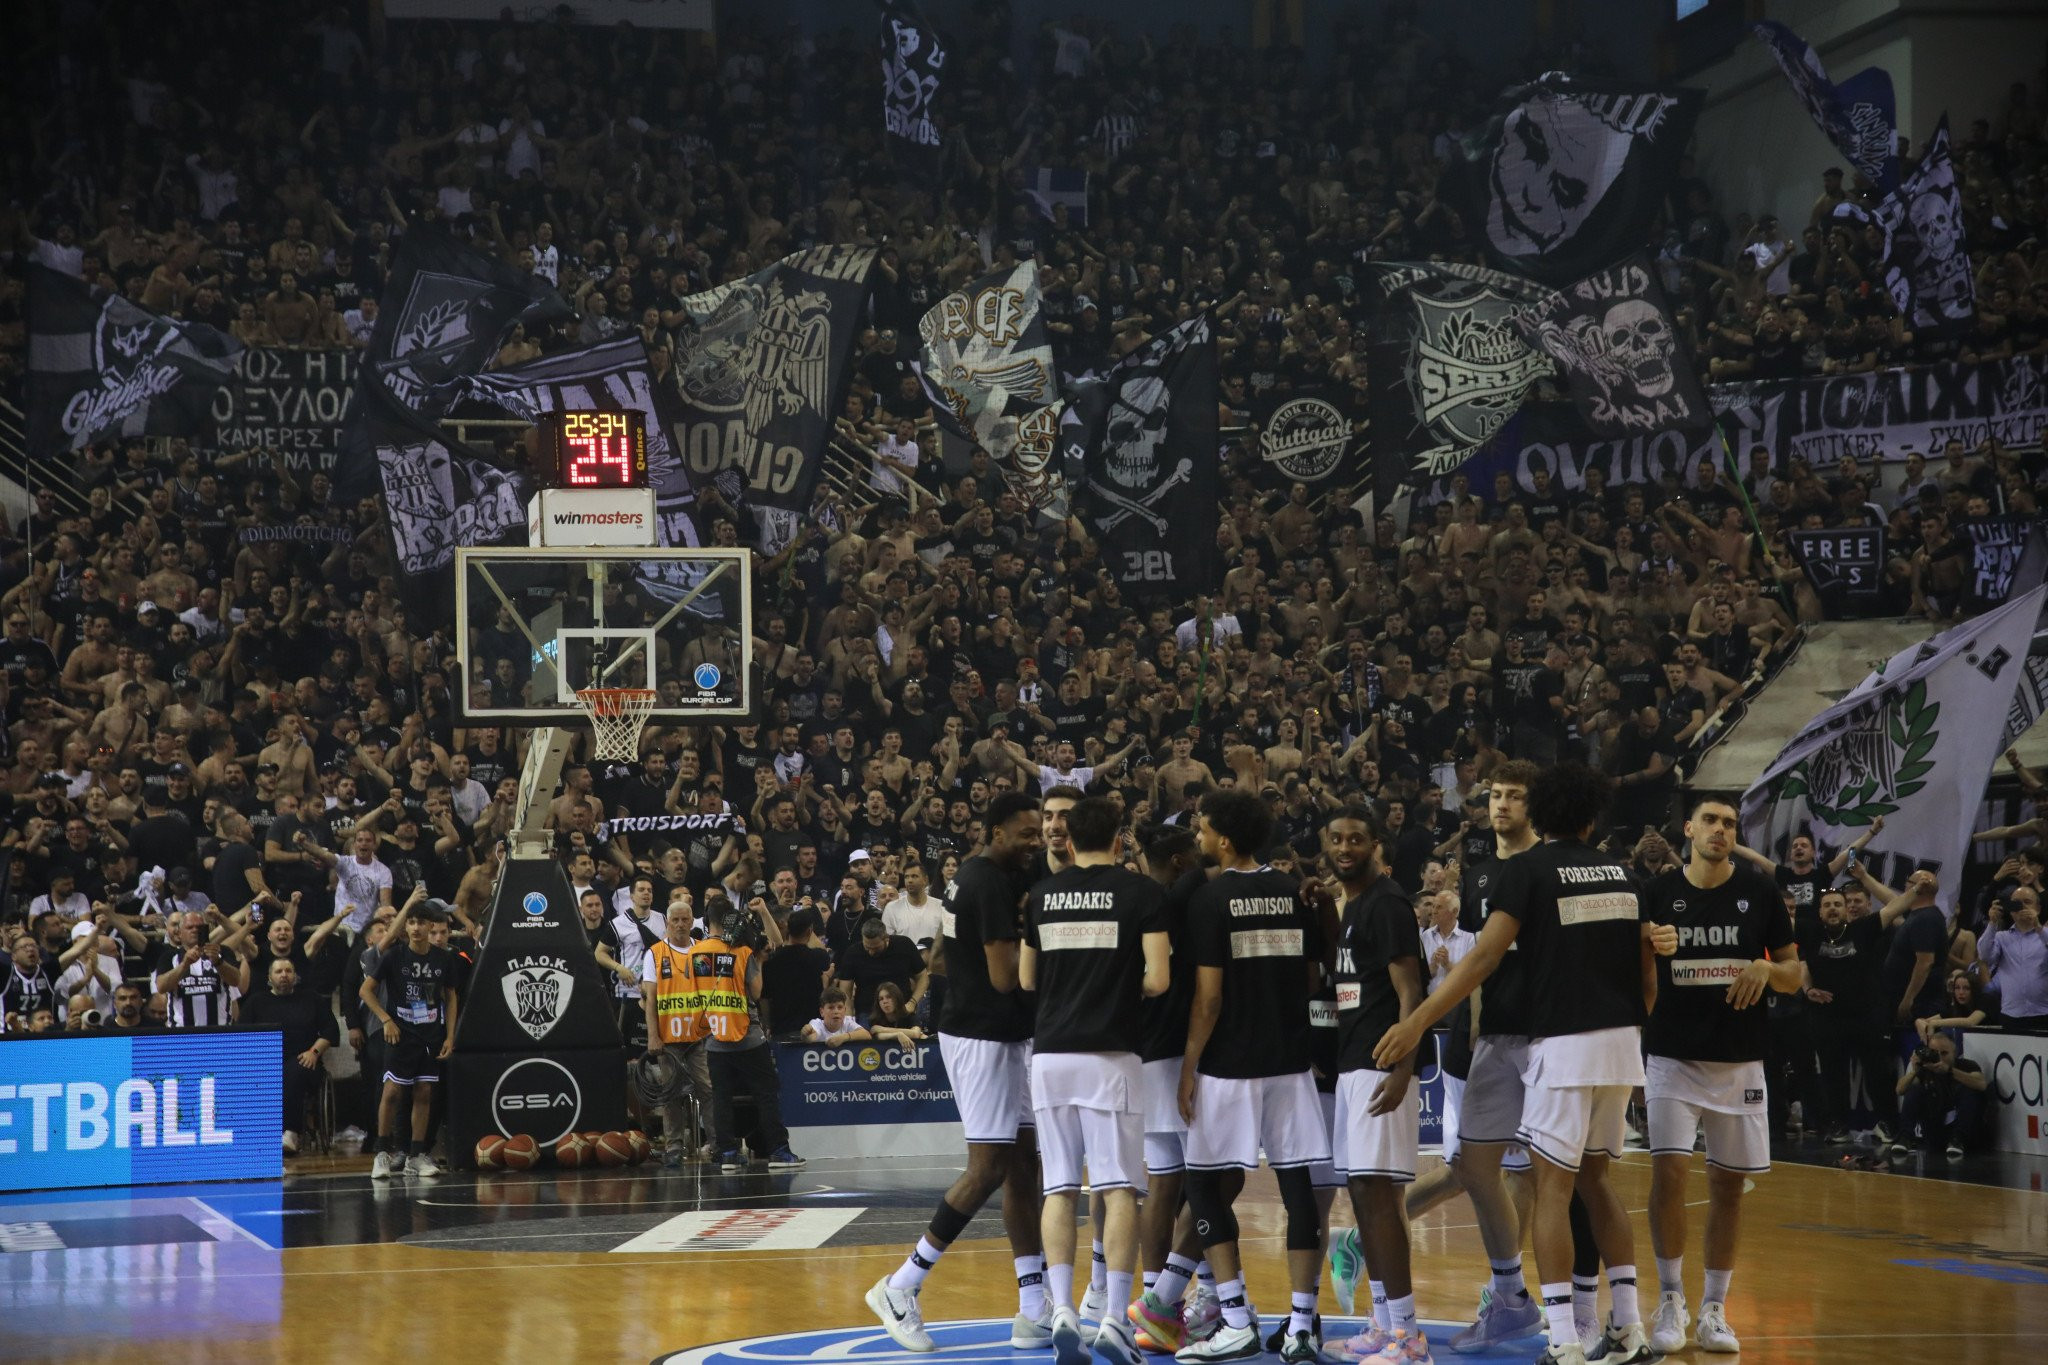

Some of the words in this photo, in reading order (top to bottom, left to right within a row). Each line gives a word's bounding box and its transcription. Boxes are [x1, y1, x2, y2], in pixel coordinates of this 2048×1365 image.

[564, 413, 628, 438] 25:34
[1272, 404, 1302, 432] PAOK
[1305, 403, 1337, 427] CLUB
[216, 427, 324, 448] ΚΑΜΕΡΕΣ
[1260, 418, 1353, 459] Stuttgart
[635, 426, 646, 472] Quince
[569, 437, 629, 484] 24
[553, 511, 643, 525] winmasters
[1802, 538, 1871, 558] FREE
[610, 812, 733, 834] TROISDORF
[1557, 865, 1628, 884] FORRESTER
[1043, 891, 1113, 912] PAPADAKIS
[1229, 896, 1294, 917] GRANDISON
[1679, 925, 1739, 946] PAOK
[412, 962, 432, 978] 34
[717, 956, 733, 966] FIBA
[1673, 965, 1745, 978] winmaster
[710, 995, 742, 1009] HOLDER
[527, 1024, 548, 1033] 1926
[708, 1014, 728, 1036] 91
[803, 1049, 855, 1072] eco
[884, 1047, 930, 1070] car
[870, 1074, 897, 1082] electric
[898, 1072, 927, 1081] vehicles
[500, 1092, 574, 1110] GSA
[804, 1091, 839, 1104] 100%
[842, 1090, 904, 1104] Ηλεκτρικά
[1020, 1272, 1043, 1287] GSA
